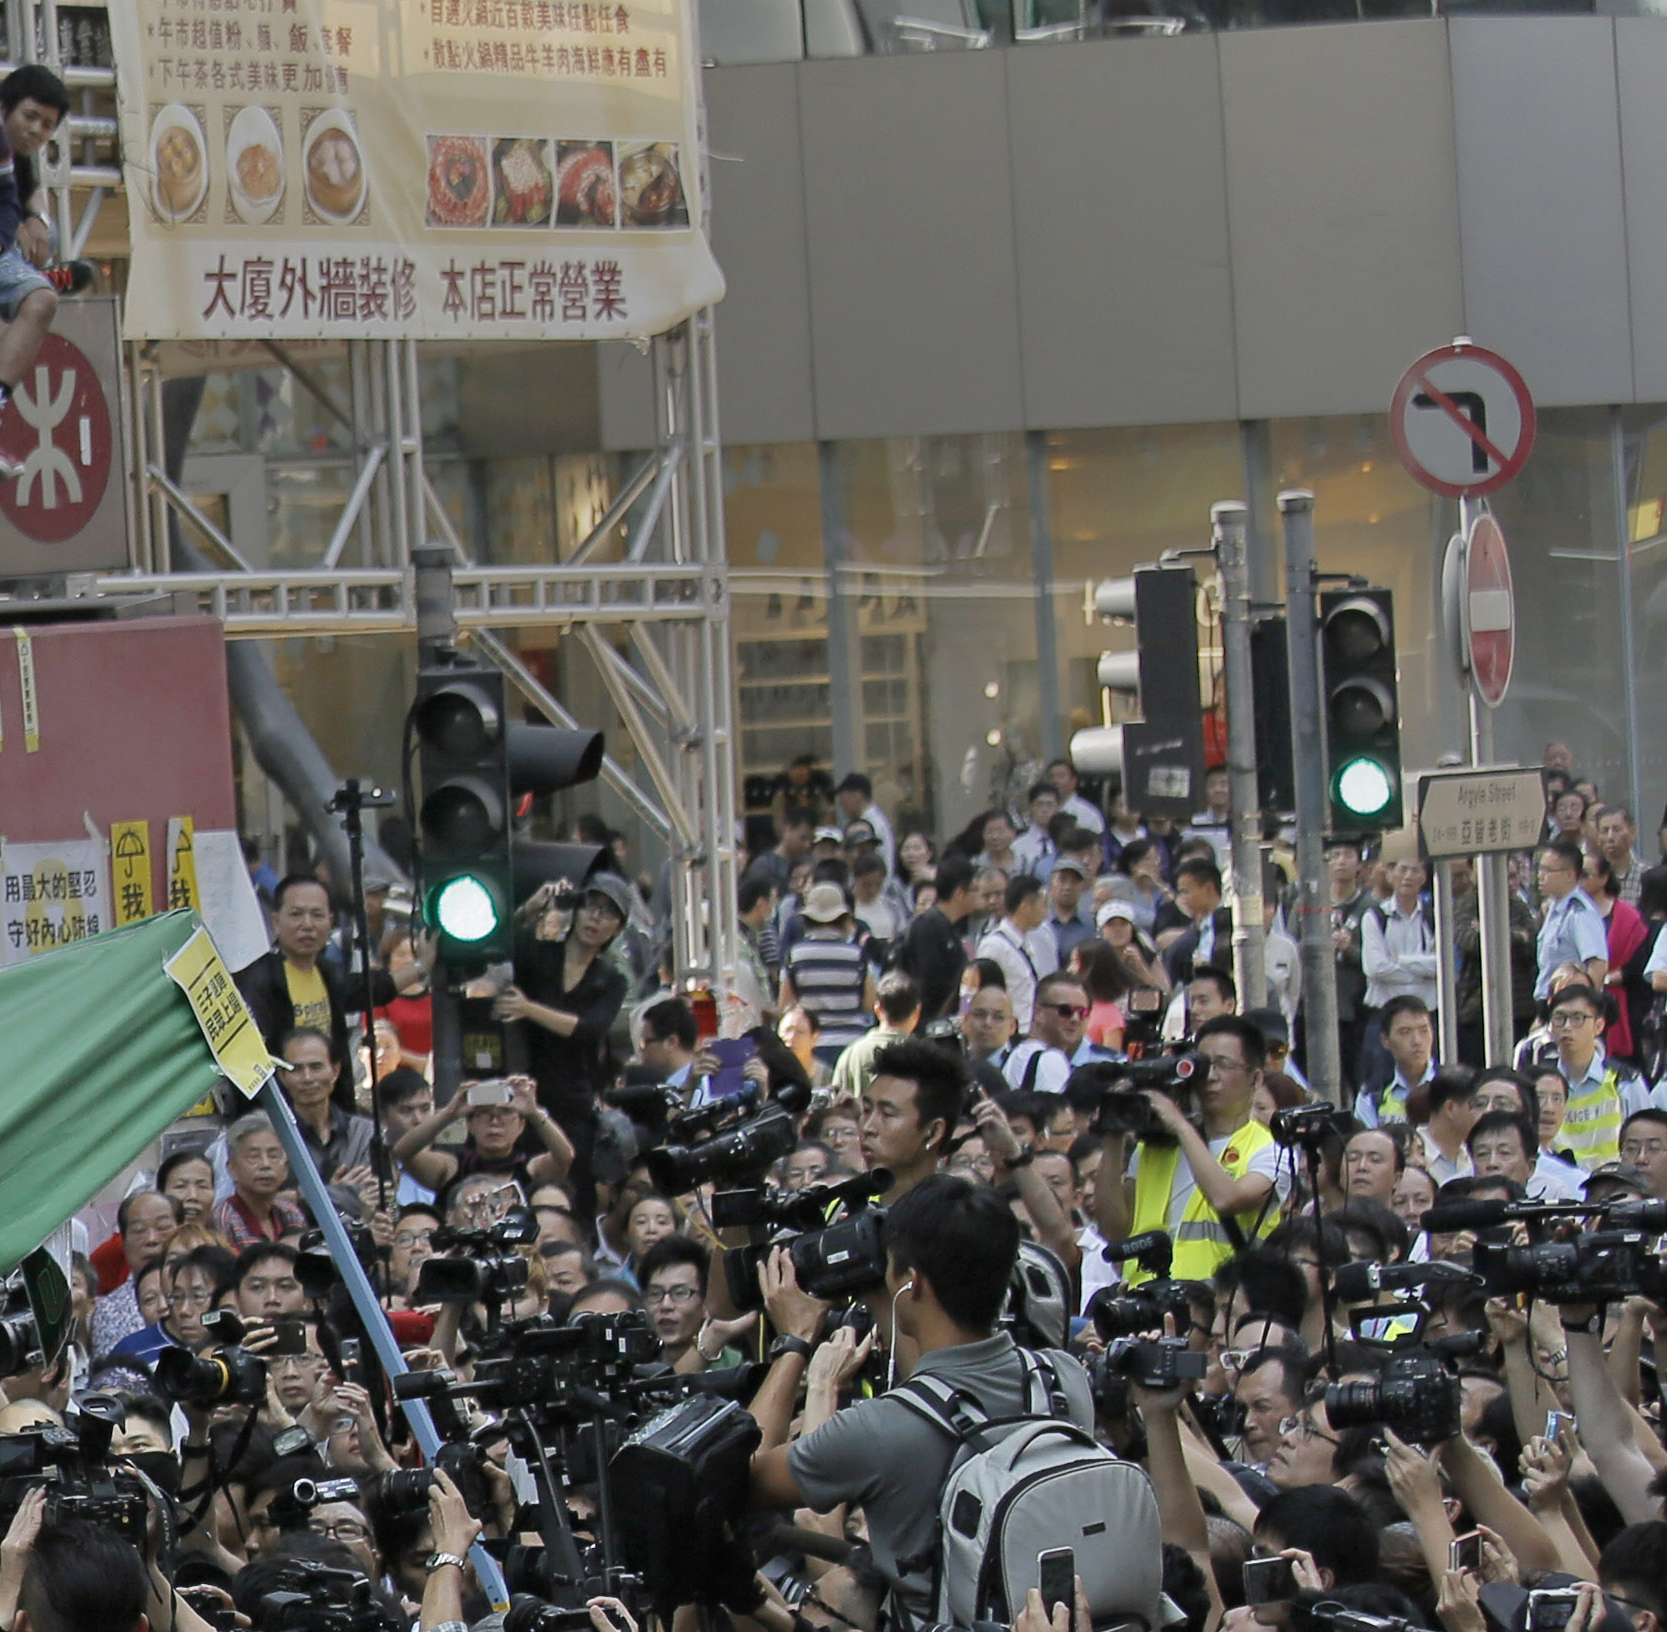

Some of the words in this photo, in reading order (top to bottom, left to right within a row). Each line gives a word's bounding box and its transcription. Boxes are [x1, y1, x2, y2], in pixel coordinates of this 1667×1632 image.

[203, 255, 416, 322] 大廈外牆裝修
[440, 257, 628, 323] 本店正常營業
[1458, 785, 1486, 808] Argyle
[1488, 782, 1516, 802] Street
[5, 870, 96, 902] 用最大的堅忍
